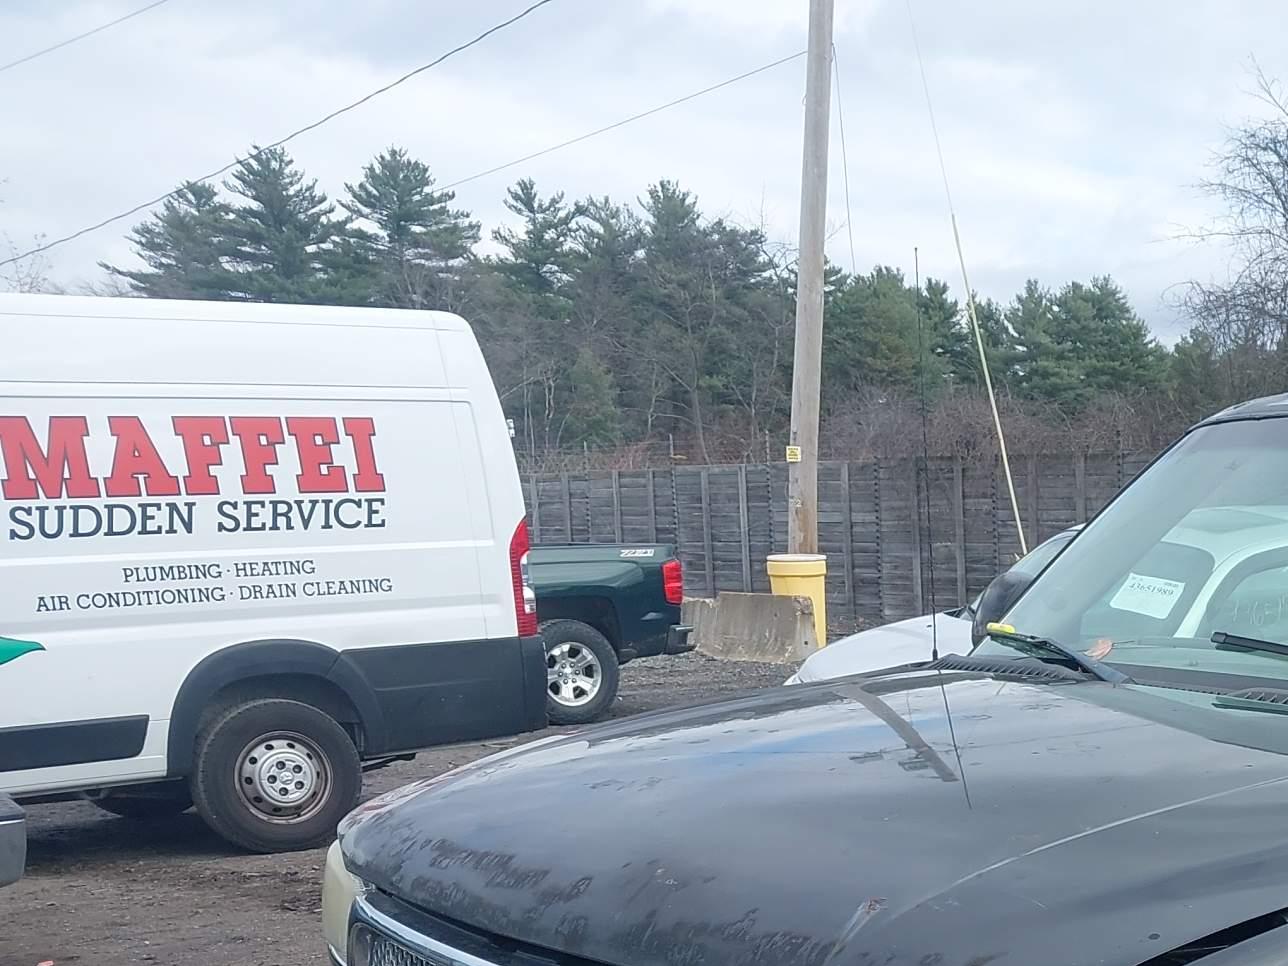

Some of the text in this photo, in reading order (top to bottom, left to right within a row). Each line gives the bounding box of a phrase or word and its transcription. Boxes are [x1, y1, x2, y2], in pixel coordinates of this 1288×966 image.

[0, 416, 386, 499] MAFFEI
[9, 498, 386, 540] SUDDEN SERVICE
[122, 559, 316, 583] PLUMBING HEATING
[36, 578, 393, 612] AIR CONDITIONING DRAIN CLEANING
